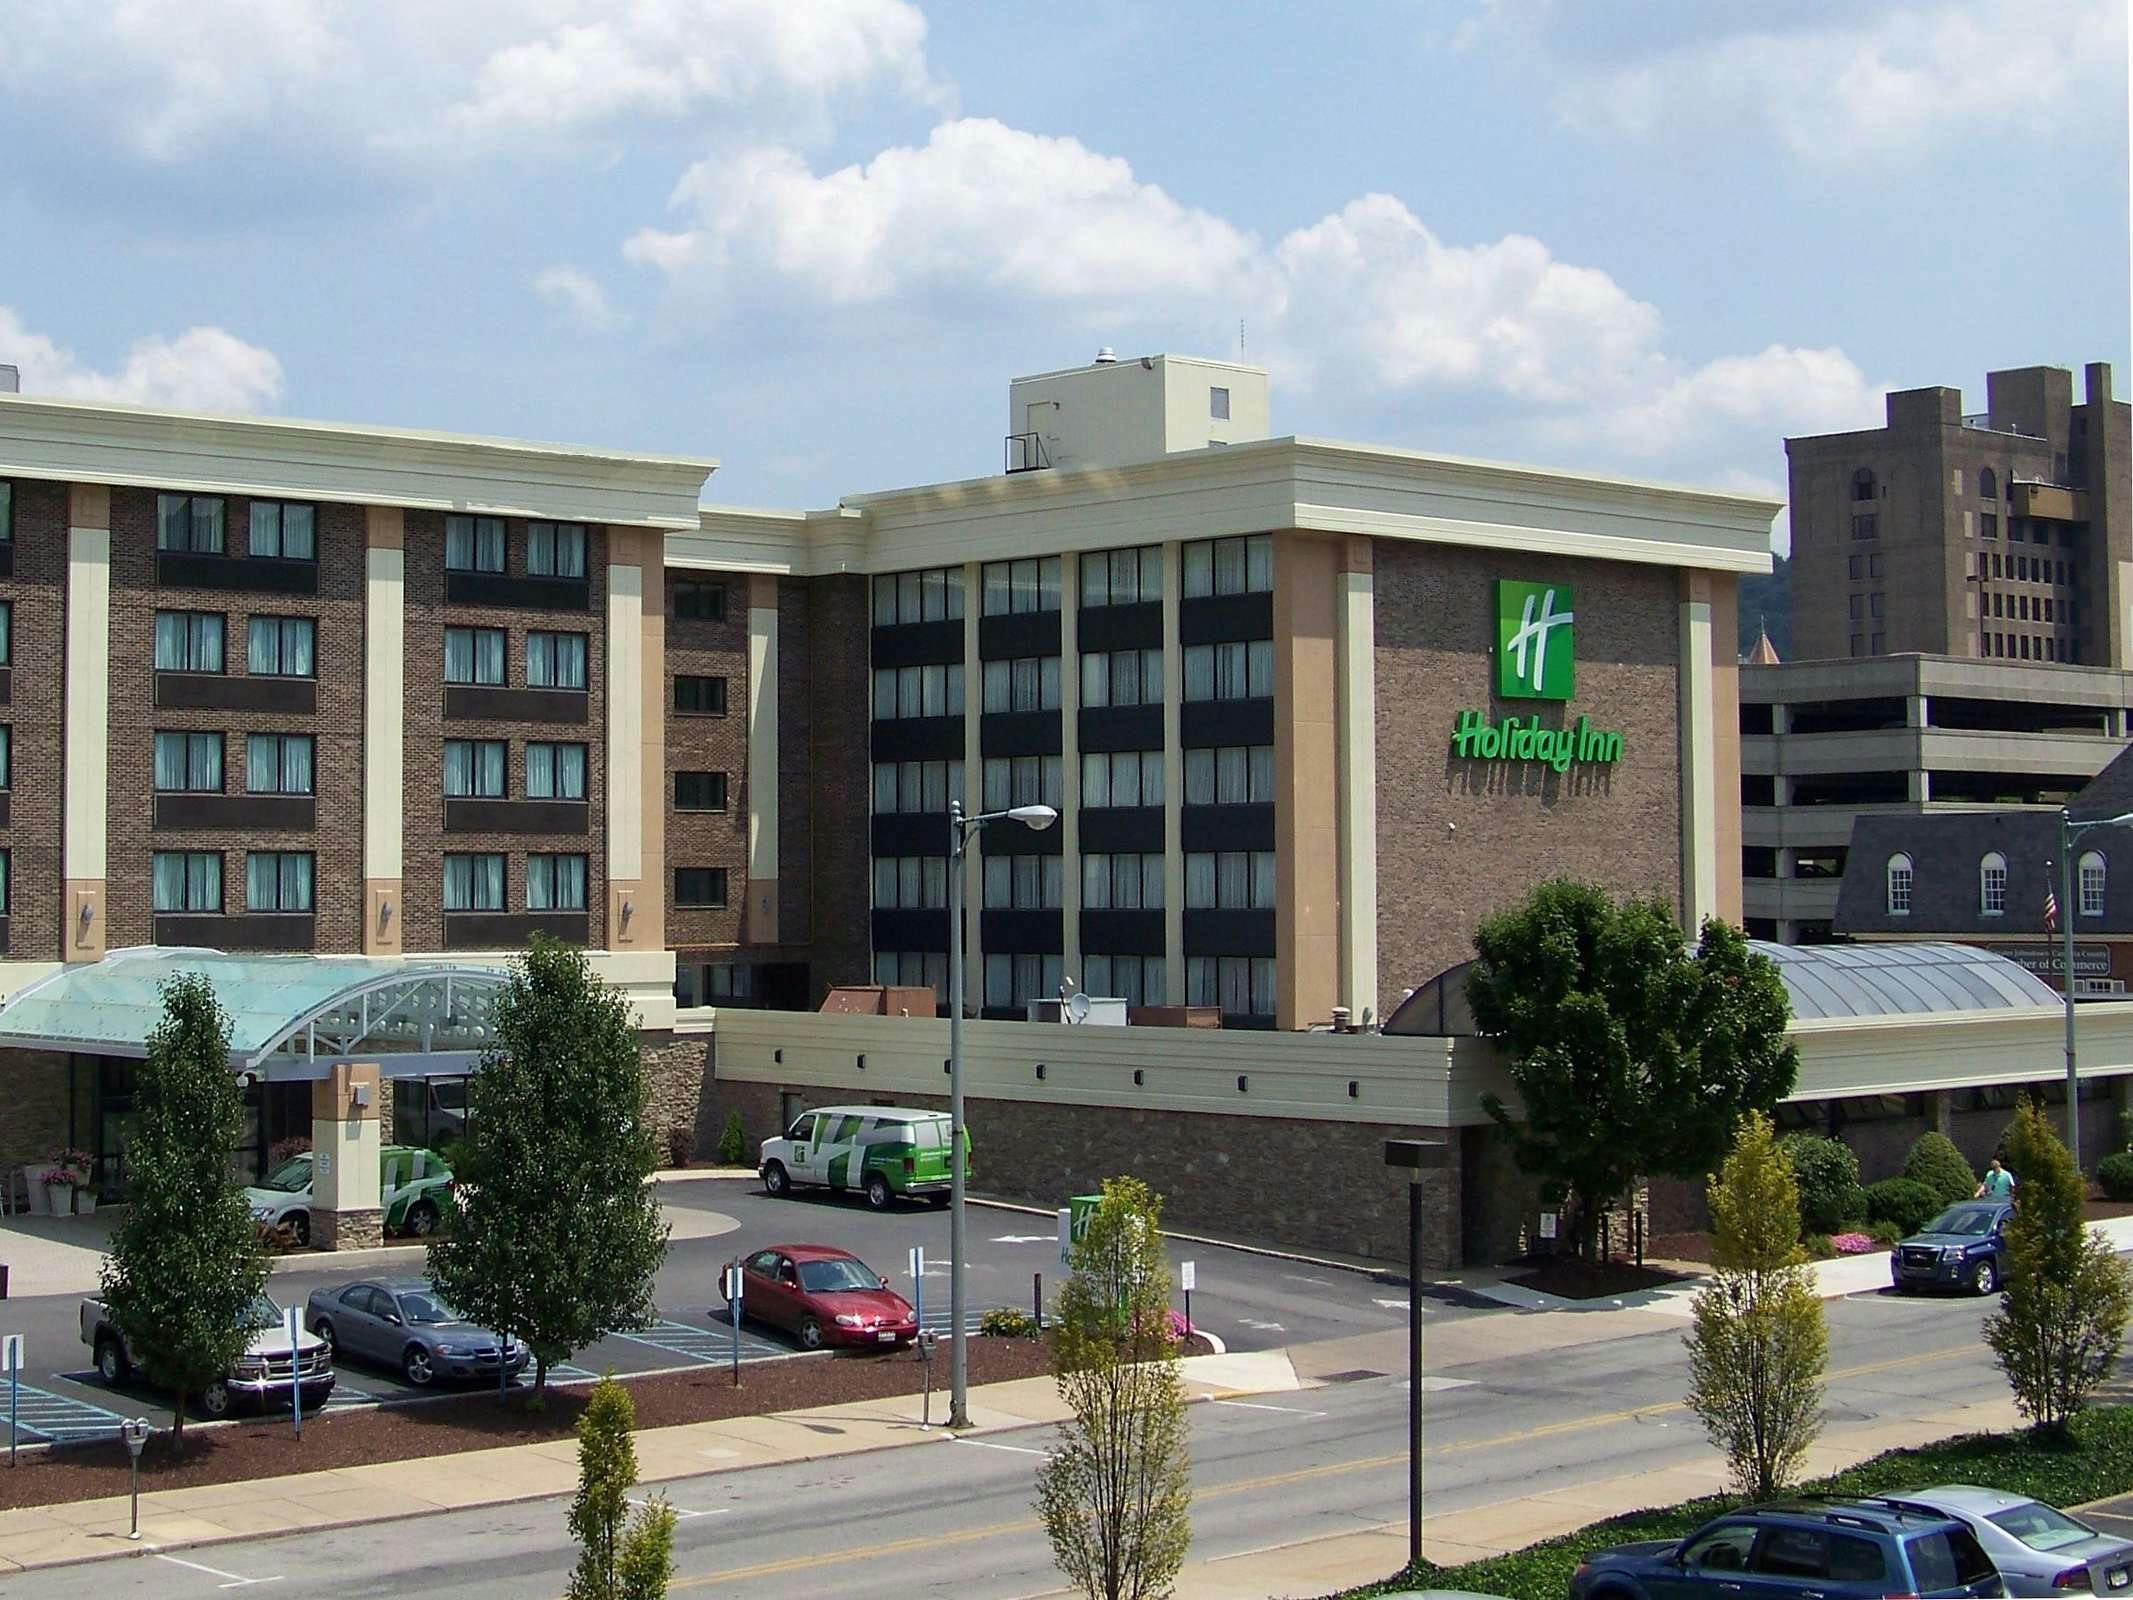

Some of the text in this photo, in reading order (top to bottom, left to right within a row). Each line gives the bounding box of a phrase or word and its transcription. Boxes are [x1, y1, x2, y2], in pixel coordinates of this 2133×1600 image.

[1452, 710, 1623, 773] Holiday Inn
[2039, 959, 2050, 969] of
[2052, 958, 2108, 970] Comerce
